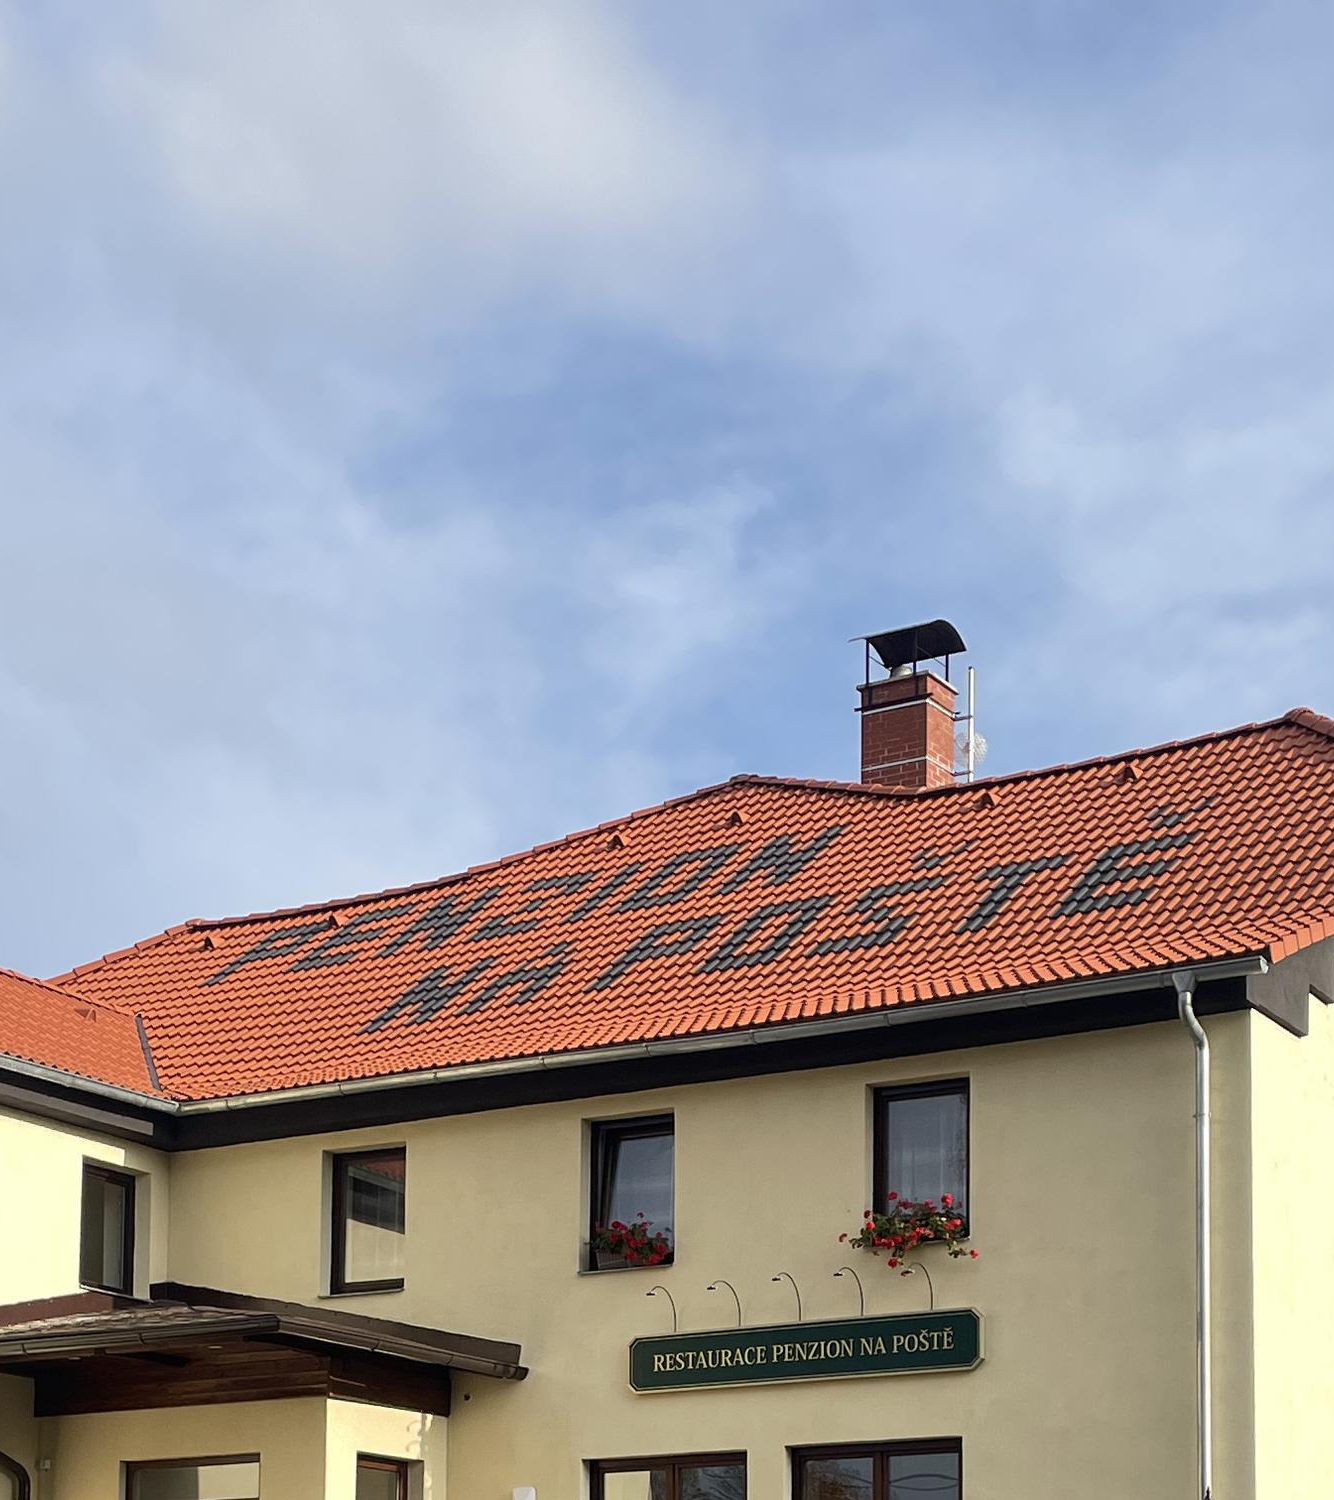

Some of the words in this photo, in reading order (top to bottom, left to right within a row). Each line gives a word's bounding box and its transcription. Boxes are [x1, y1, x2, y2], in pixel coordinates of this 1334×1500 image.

[197, 823, 847, 988] PENZION
[357, 938, 570, 1036] NA
[581, 799, 1218, 993] POŠTĚ
[653, 1345, 767, 1372] RESTAURACE
[771, 1338, 854, 1363] PENZION
[859, 1336, 887, 1356] NA
[891, 1326, 955, 1354] POŠTĚ
